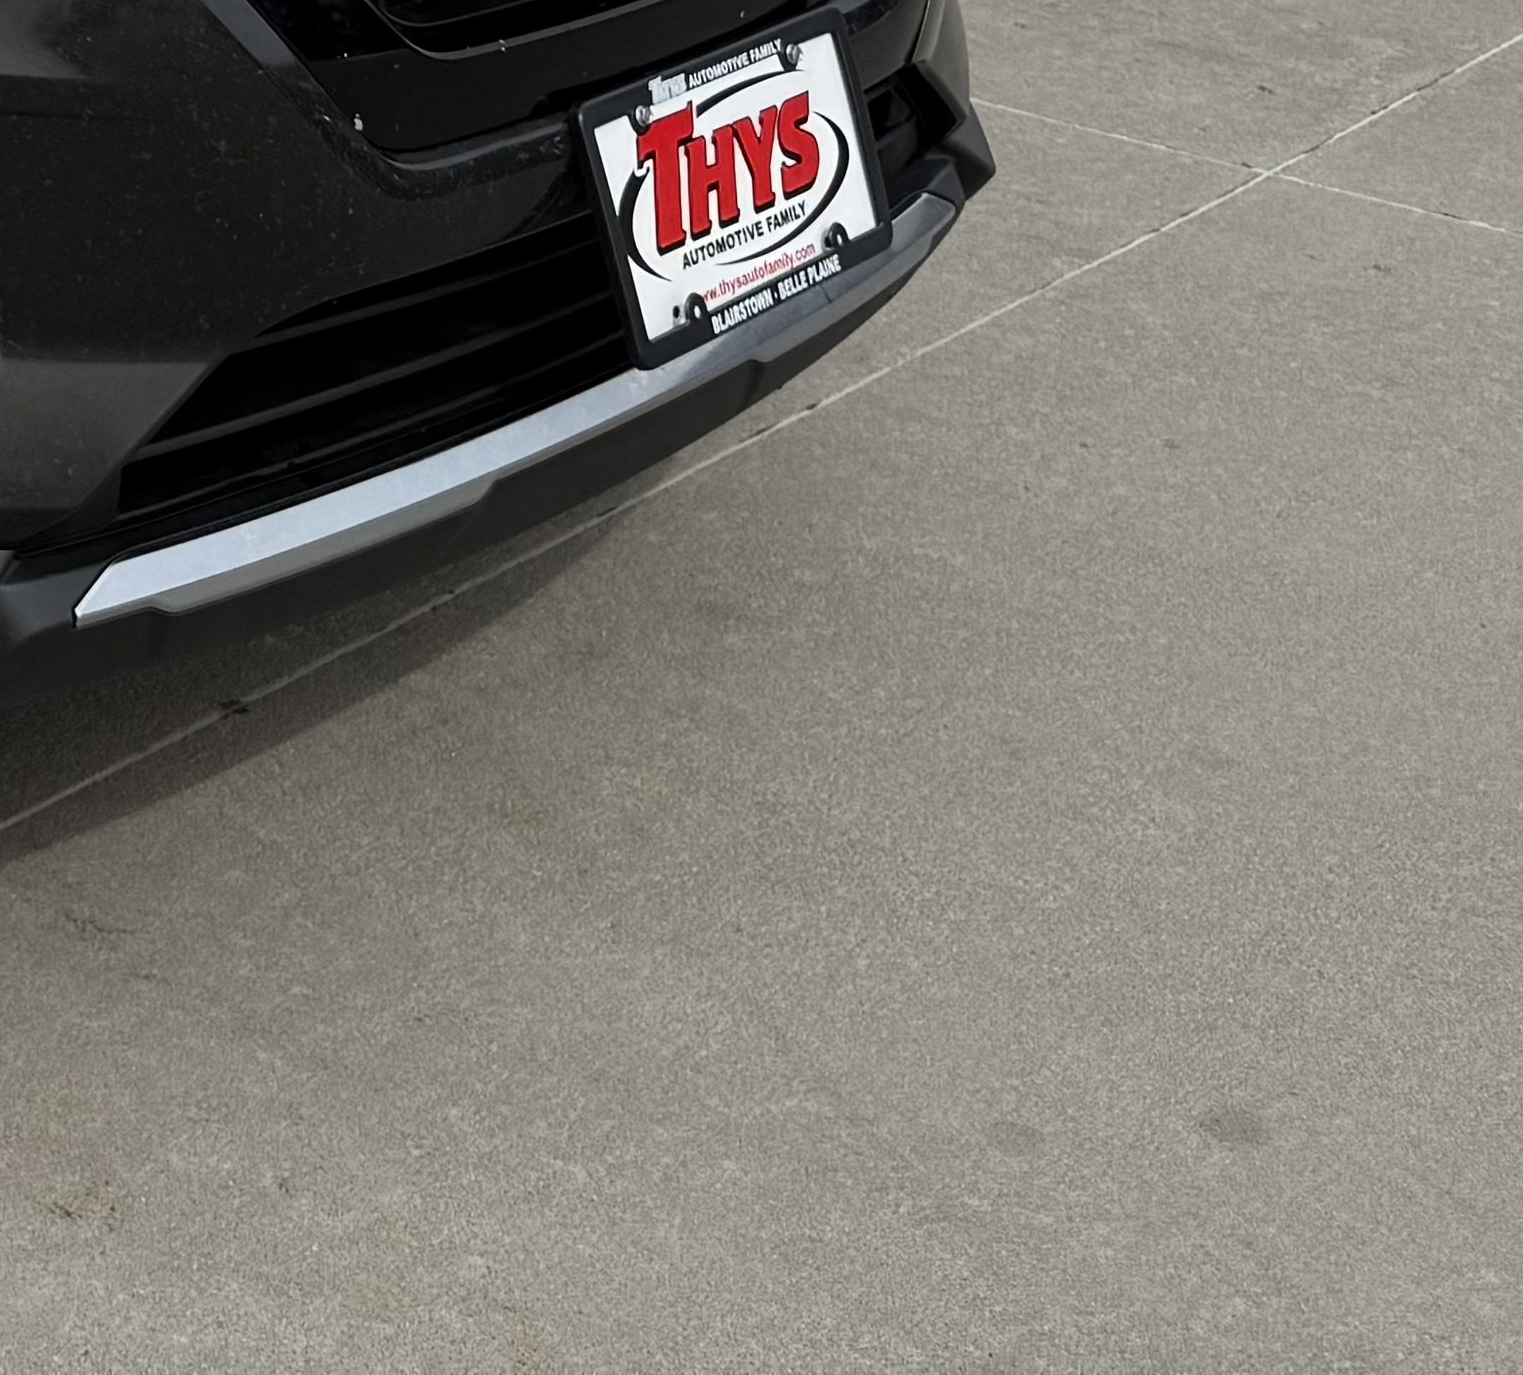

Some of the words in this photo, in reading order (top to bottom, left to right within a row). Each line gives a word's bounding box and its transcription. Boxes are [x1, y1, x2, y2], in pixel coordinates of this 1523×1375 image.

[688, 52, 750, 89] AUTOMOTIVE
[749, 37, 783, 66] FAMILY
[636, 90, 821, 256] THYS
[682, 220, 765, 270] AUTOMOTIVE
[765, 200, 807, 234] FAMILY
[711, 287, 775, 335] BLAIRSTOWN
[777, 273, 808, 301] BELLE
[806, 254, 842, 288] PLAINE
